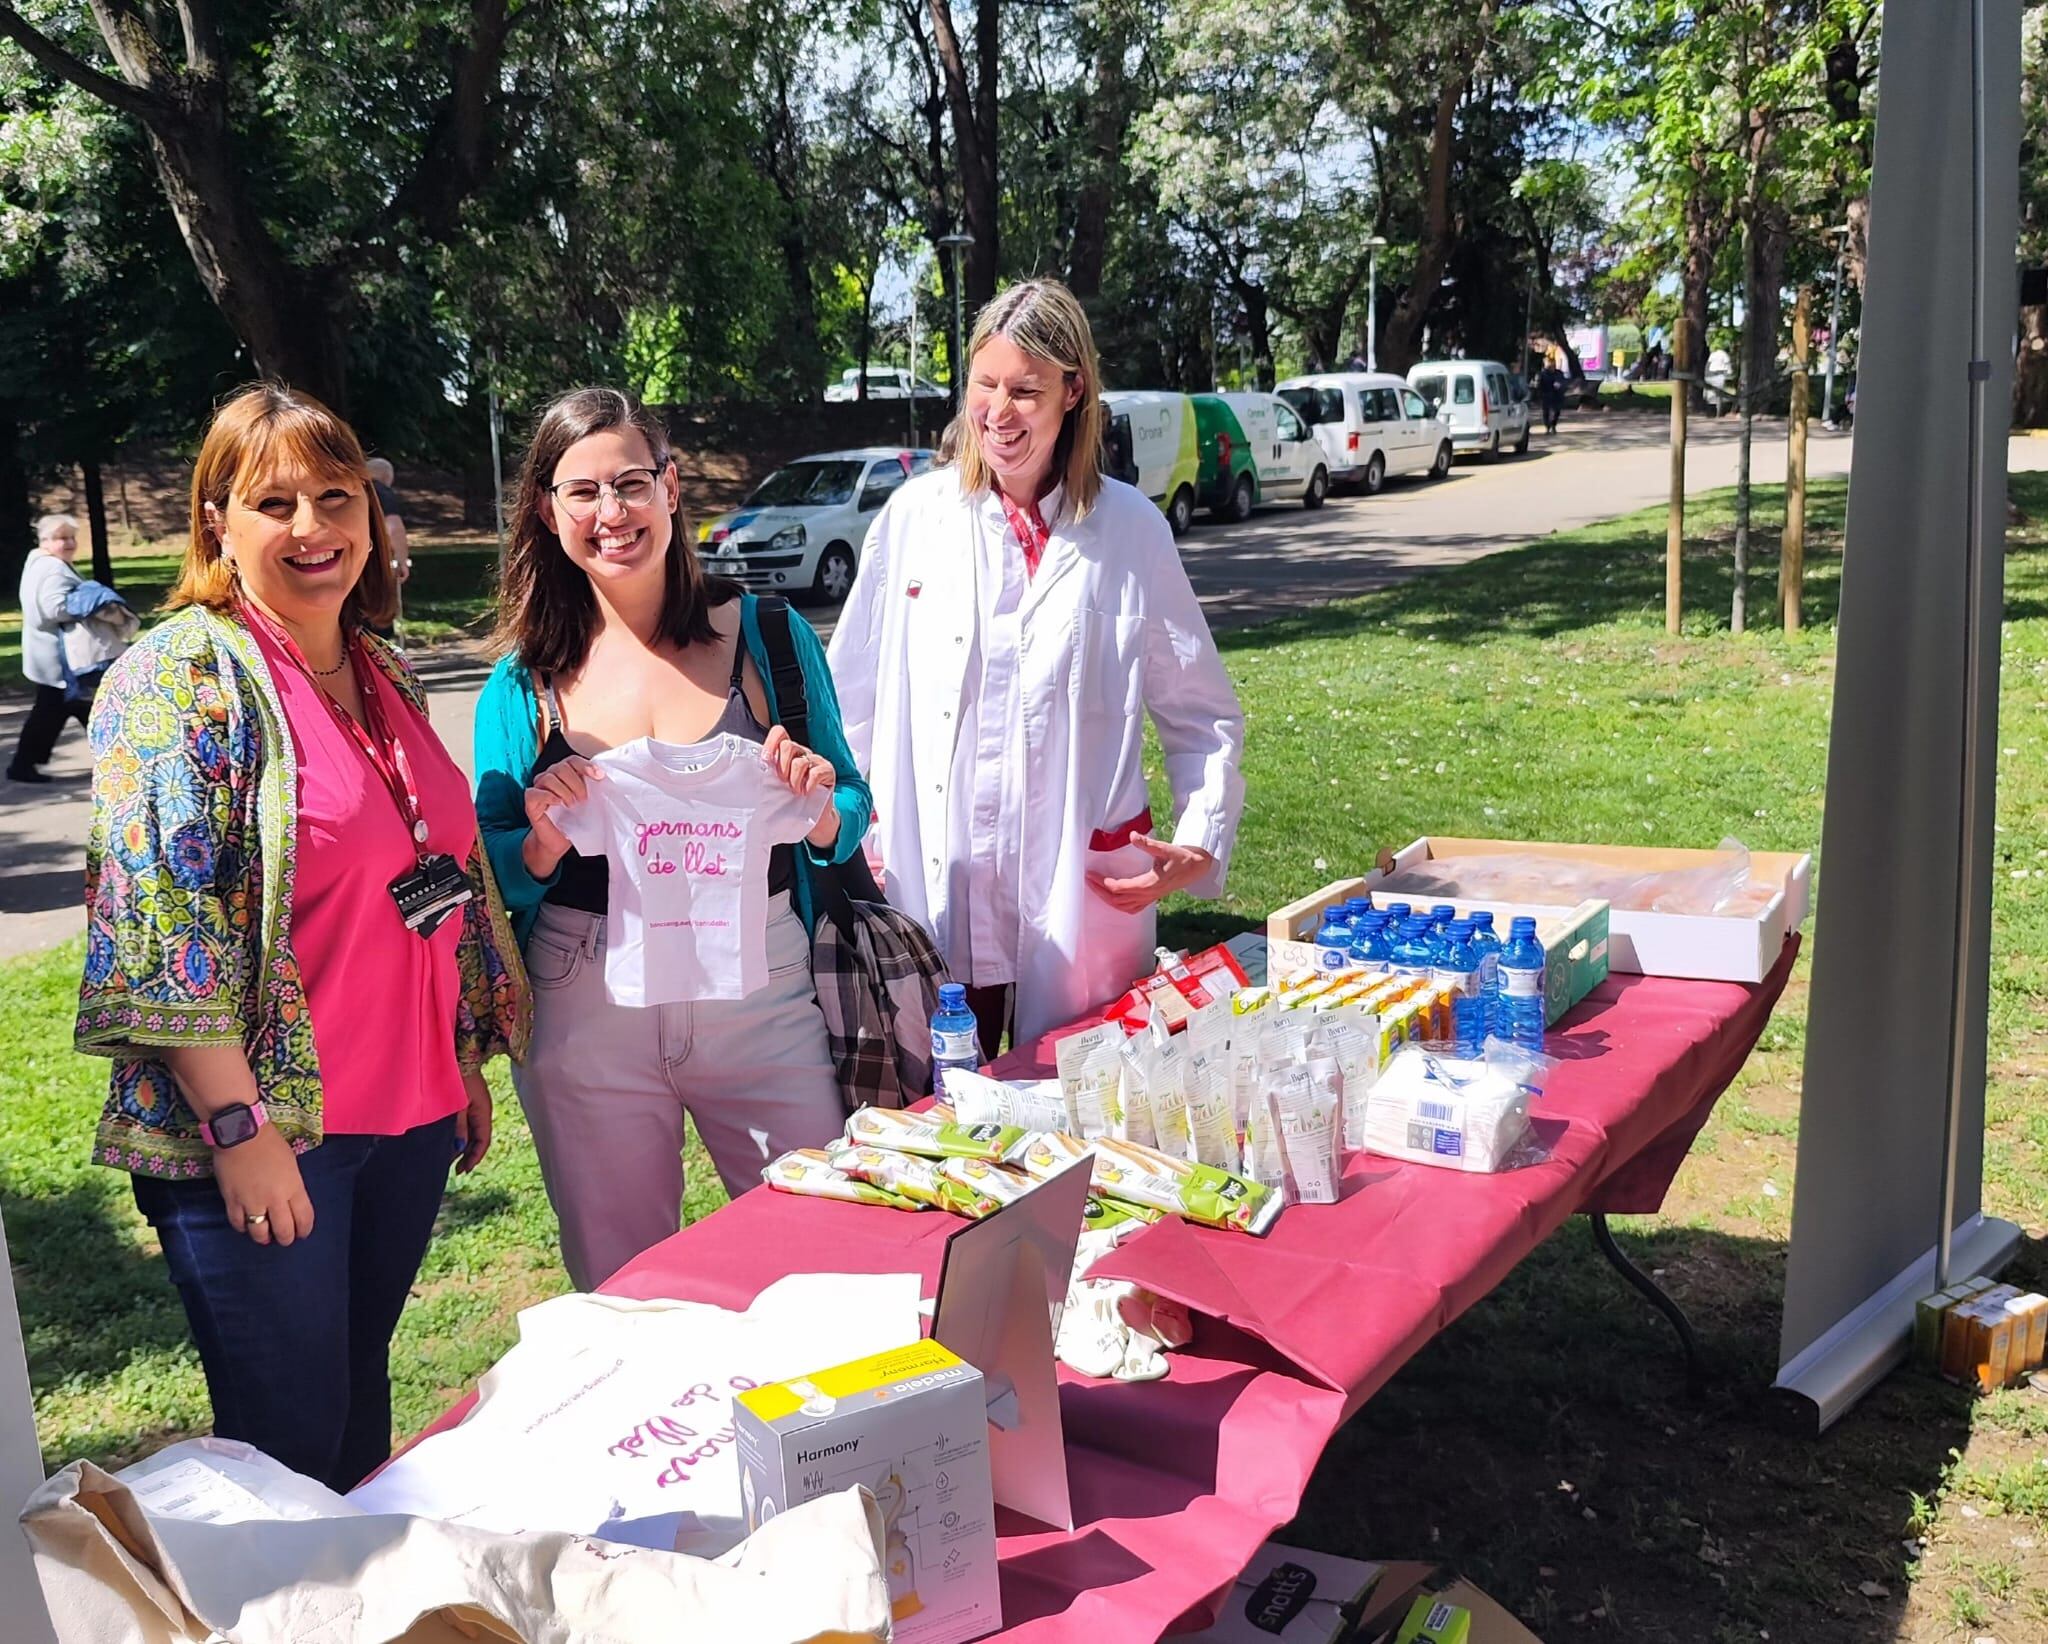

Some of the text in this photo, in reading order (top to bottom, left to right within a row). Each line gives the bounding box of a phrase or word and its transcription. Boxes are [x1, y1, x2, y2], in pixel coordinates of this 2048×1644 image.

[634, 820, 742, 856] germans
[647, 842, 728, 876] de llet
[883, 1357, 946, 1378] Harmony
[892, 1368, 964, 1394] medela
[796, 1438, 860, 1465] Harmony
